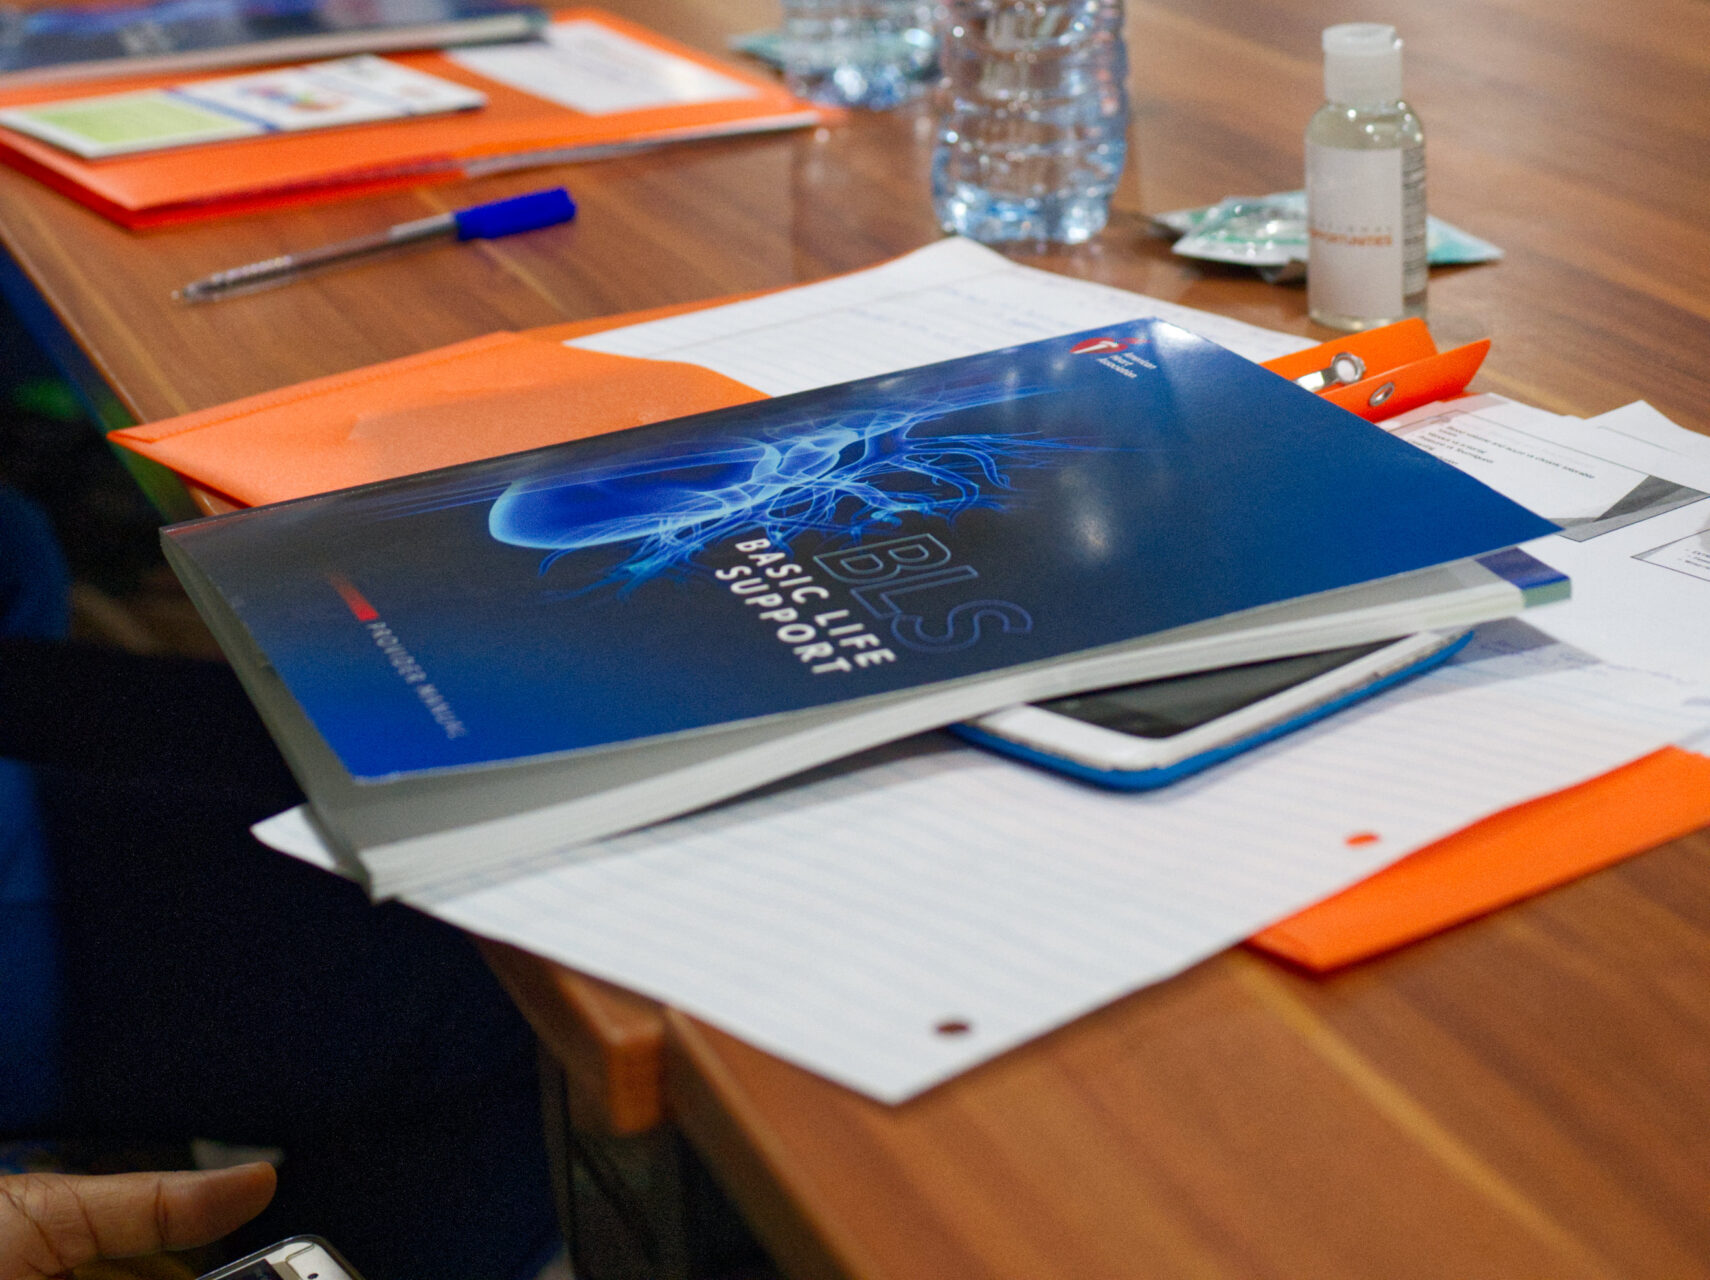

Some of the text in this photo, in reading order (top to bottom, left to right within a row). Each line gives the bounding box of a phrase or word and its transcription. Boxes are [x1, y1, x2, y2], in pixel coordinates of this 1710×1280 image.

[714, 565, 853, 675] SUPPORT
[734, 537, 897, 669] BASIC LIFE
[813, 532, 1034, 655] BLS
[366, 621, 427, 684] PROVIDER
